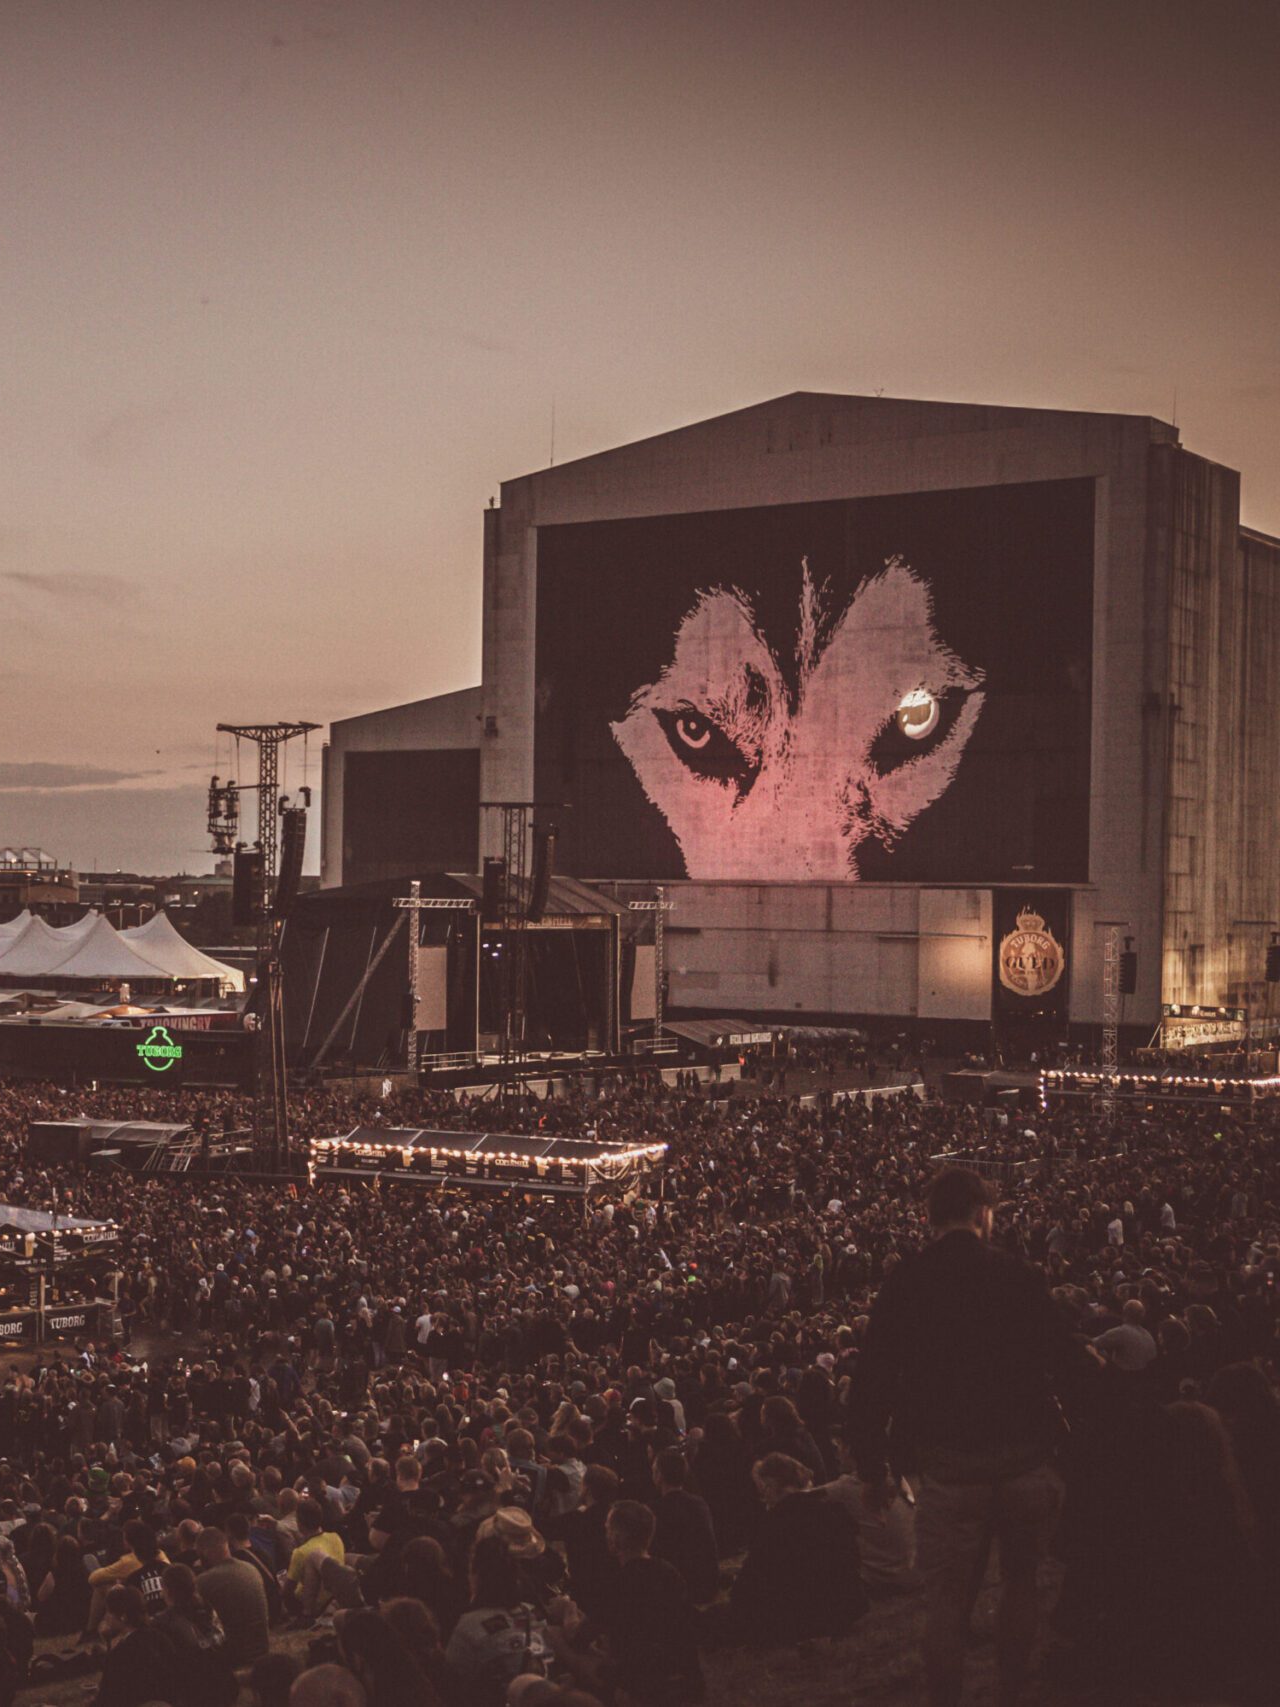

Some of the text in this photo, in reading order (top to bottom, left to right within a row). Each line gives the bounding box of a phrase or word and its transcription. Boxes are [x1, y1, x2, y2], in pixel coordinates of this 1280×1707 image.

[1010, 933, 1051, 950] TUBORG
[136, 1044, 182, 1058] TUBORG
[49, 1315, 86, 1330] TUBORG
